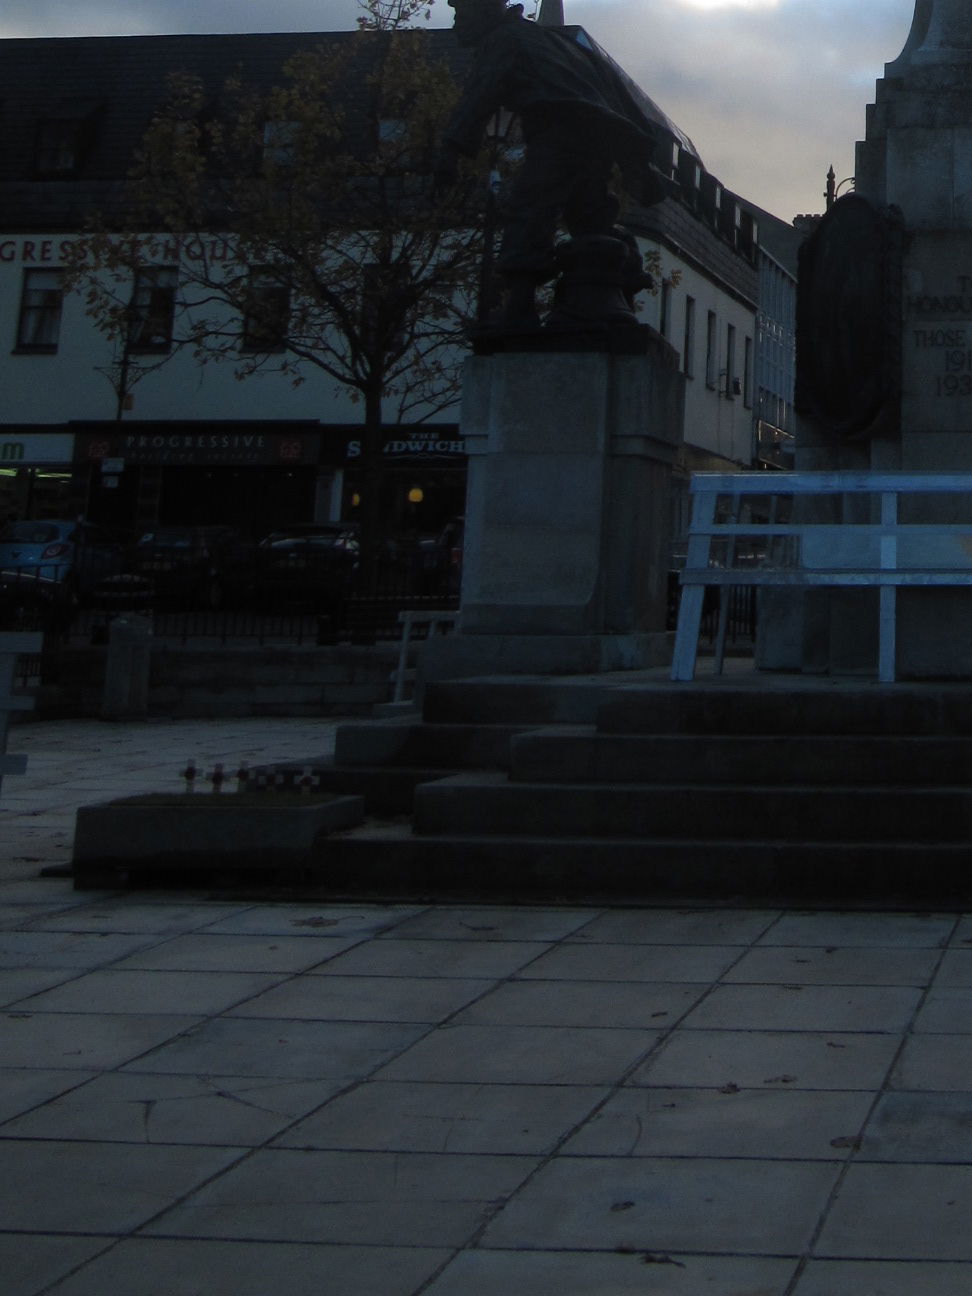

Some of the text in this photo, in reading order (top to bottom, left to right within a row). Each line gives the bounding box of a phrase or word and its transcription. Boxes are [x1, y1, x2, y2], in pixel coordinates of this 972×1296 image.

[913, 330, 966, 347] THOSE
[127, 435, 265, 449] PROGRESSIVE
[408, 431, 440, 440] THE
[345, 439, 465, 457] SDWICH
